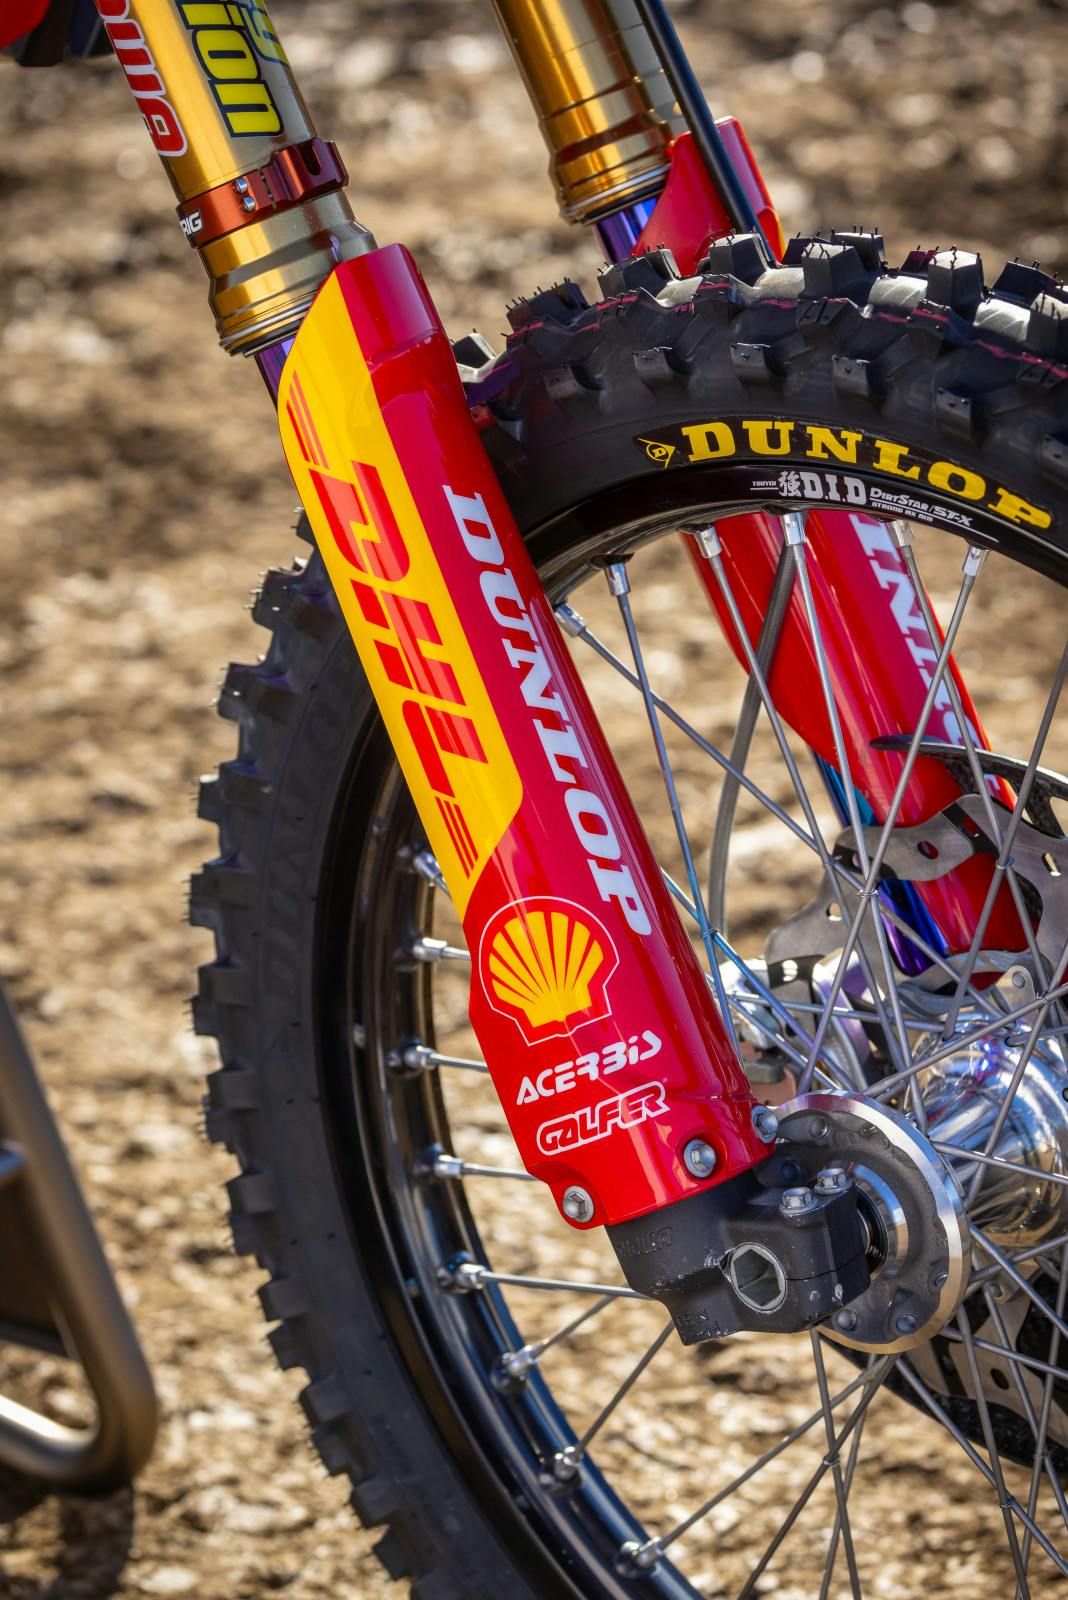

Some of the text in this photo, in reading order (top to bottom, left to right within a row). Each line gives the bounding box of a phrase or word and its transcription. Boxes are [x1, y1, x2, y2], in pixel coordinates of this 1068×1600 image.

[682, 420, 1052, 529] DUNLOP
[307, 460, 488, 798] DHL
[442, 484, 653, 936] DUNLOP
[536, 1081, 671, 1156] GALFER
